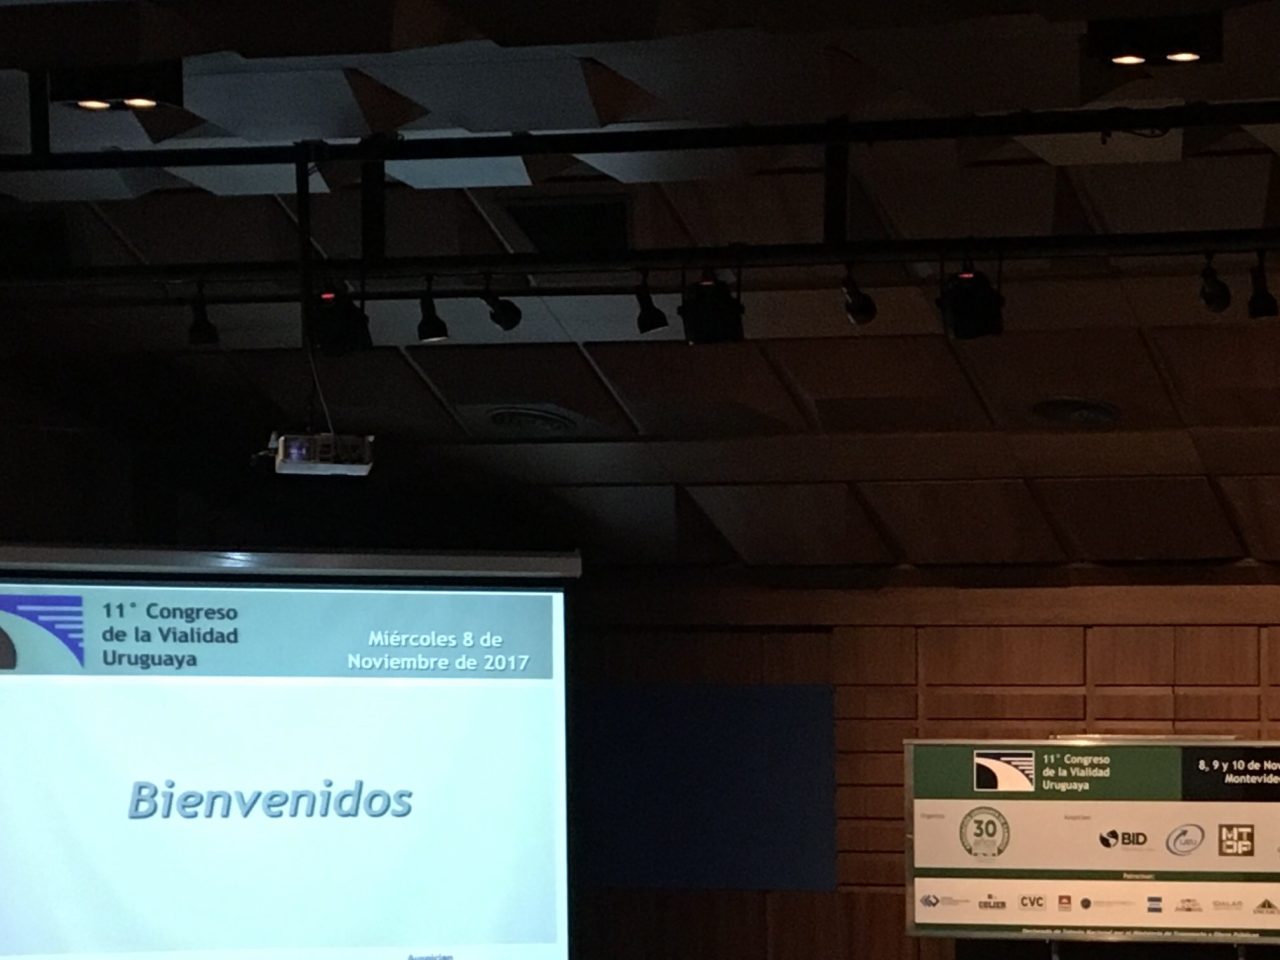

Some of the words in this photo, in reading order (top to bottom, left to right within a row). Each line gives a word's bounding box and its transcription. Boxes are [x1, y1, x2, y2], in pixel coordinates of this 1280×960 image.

[146, 602, 238, 623] Congreso
[102, 626, 127, 642] de
[134, 626, 152, 642] la
[158, 627, 239, 643] Vialidad
[368, 630, 456, 647] Miércoles
[462, 632, 474, 647] 8
[479, 632, 503, 647] de
[102, 650, 197, 670] Uruguaya
[348, 653, 449, 669] Noviembre
[455, 654, 478, 670] de
[484, 655, 530, 670] 2017
[1064, 754, 1111, 766] Congreso
[1198, 760, 1210, 772] 8,
[1212, 760, 1219, 770] 9
[1222, 761, 1229, 772] y
[1232, 760, 1245, 770] 10
[1247, 760, 1261, 771] de
[1042, 767, 1055, 777] de
[1058, 767, 1067, 777] la
[1070, 767, 1110, 777] Vialidad
[1042, 780, 1089, 792] Uruguaya
[128, 779, 413, 820] Bienvenidos
[973, 819, 997, 838] 30
[1121, 832, 1148, 845] BID
[1021, 897, 1044, 907] CVC
